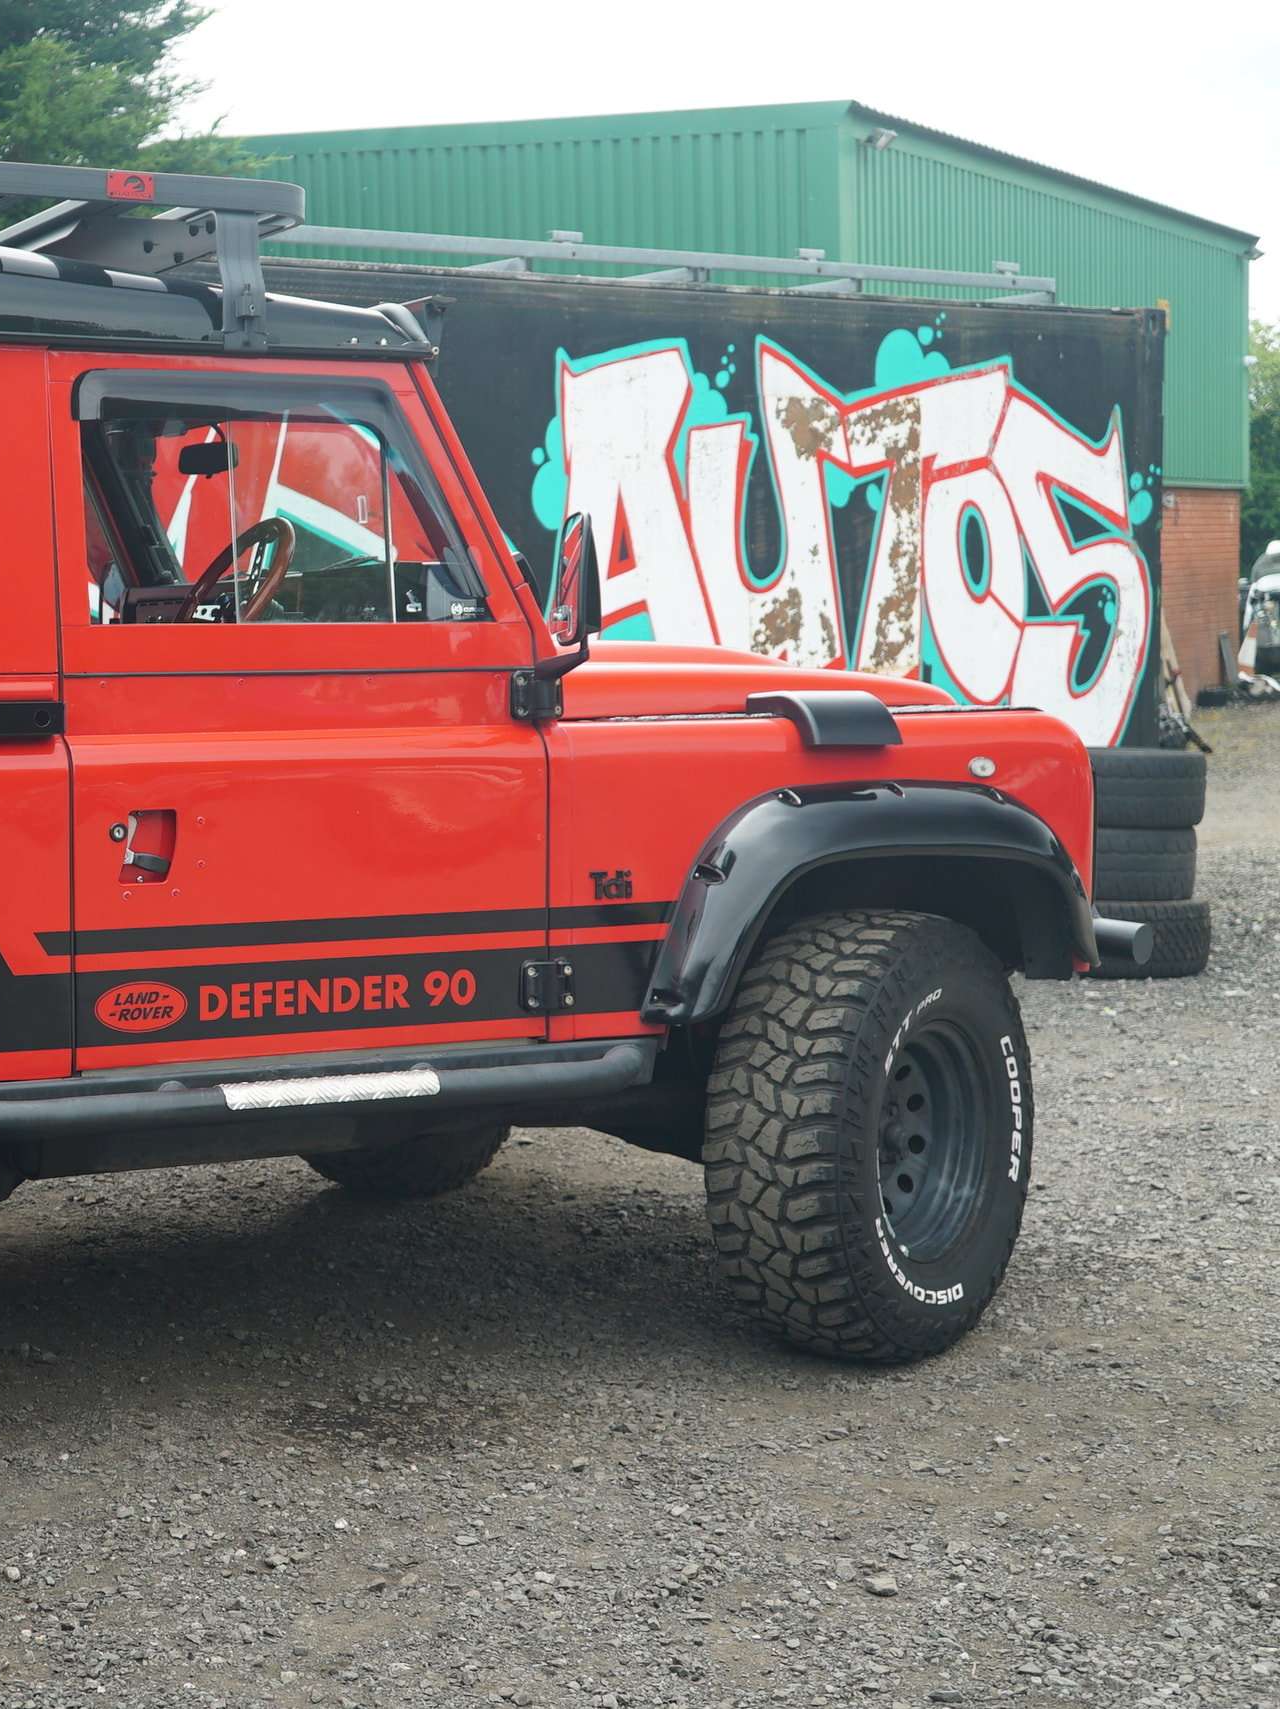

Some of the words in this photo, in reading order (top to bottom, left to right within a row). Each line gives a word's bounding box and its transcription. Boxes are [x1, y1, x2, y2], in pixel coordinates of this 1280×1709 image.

[552, 335, 1152, 748] AUTOS
[589, 869, 632, 900] Tdi
[114, 991, 159, 1006] LAND
[118, 1006, 173, 1021] ROVER
[199, 974, 410, 1021] DEFENDER
[424, 969, 477, 1006] 90
[916, 988, 942, 1015] PRO
[1000, 1035, 1022, 1182] COOPER
[875, 1217, 964, 1305] DISCOVERER
